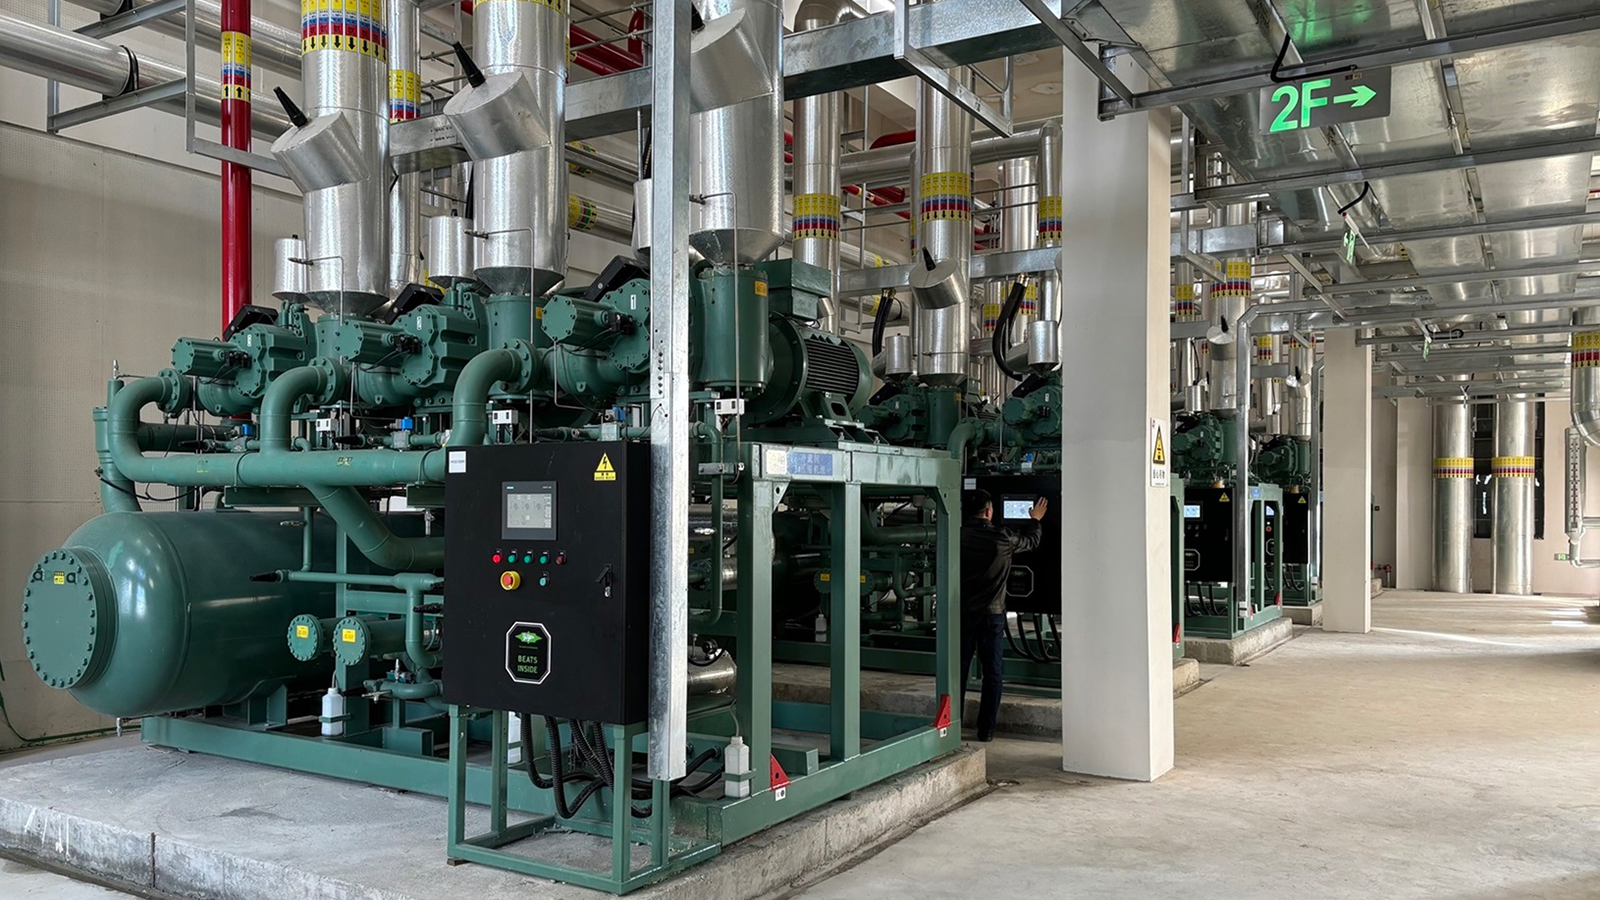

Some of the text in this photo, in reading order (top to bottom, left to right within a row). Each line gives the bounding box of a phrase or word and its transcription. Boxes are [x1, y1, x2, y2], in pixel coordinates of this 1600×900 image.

[1269, 78, 1331, 133] 2F
[517, 654, 538, 664] BEATS
[517, 665, 538, 674] INSIDE
